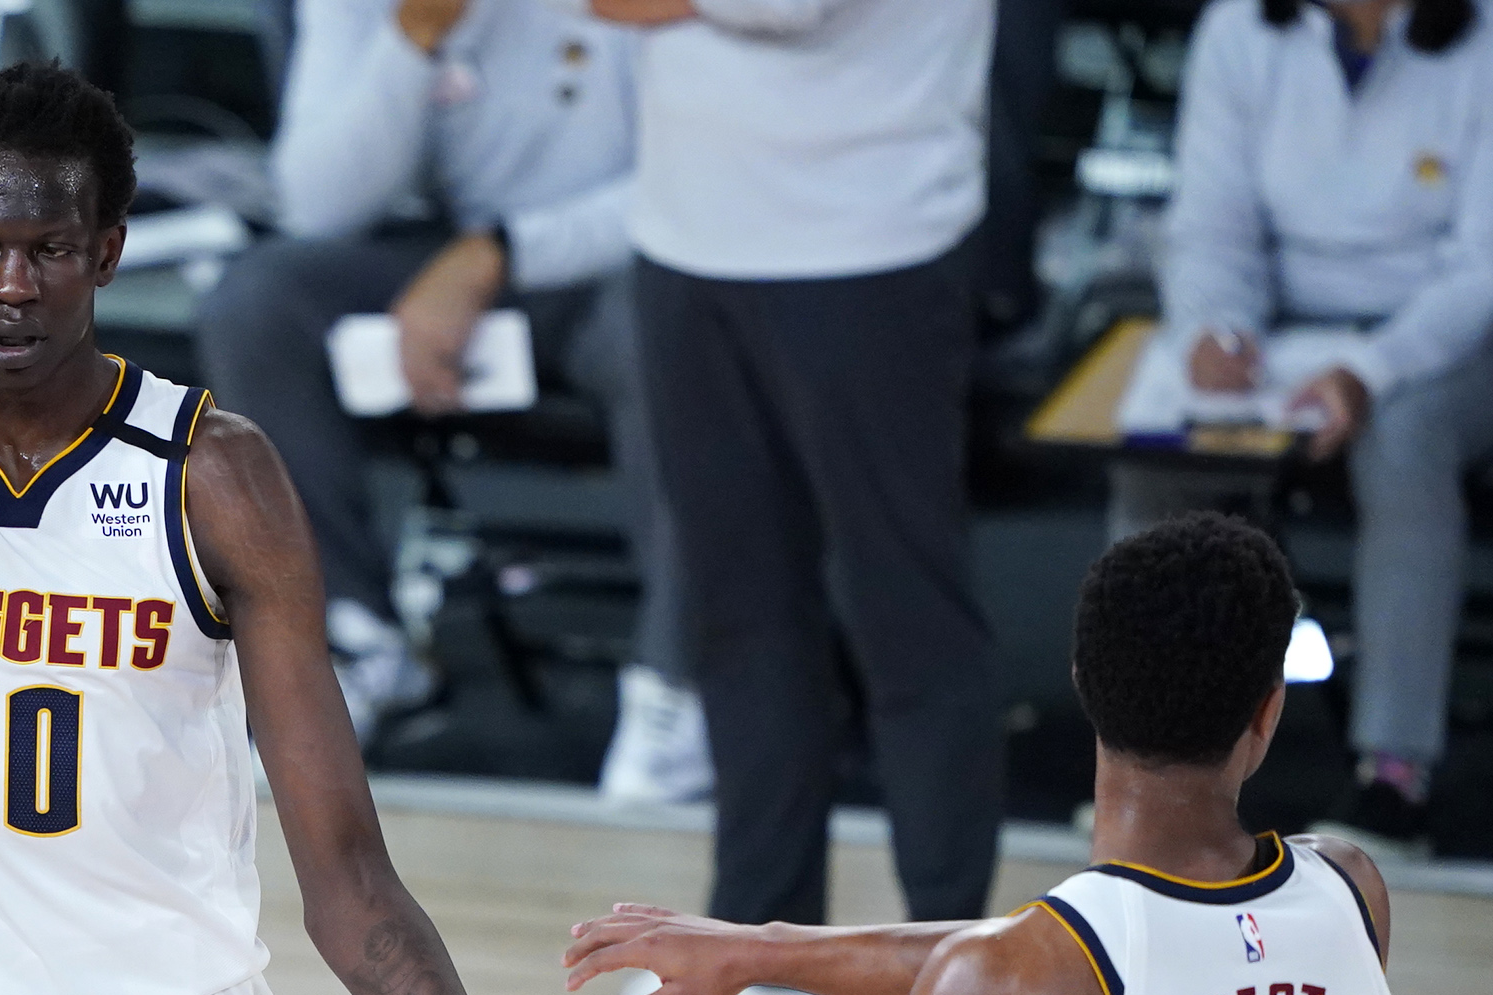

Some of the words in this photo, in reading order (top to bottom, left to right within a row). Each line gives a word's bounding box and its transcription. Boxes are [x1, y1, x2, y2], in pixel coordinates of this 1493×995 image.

[90, 482, 148, 509] WU
[91, 513, 151, 525] Western
[102, 525, 142, 537] Union
